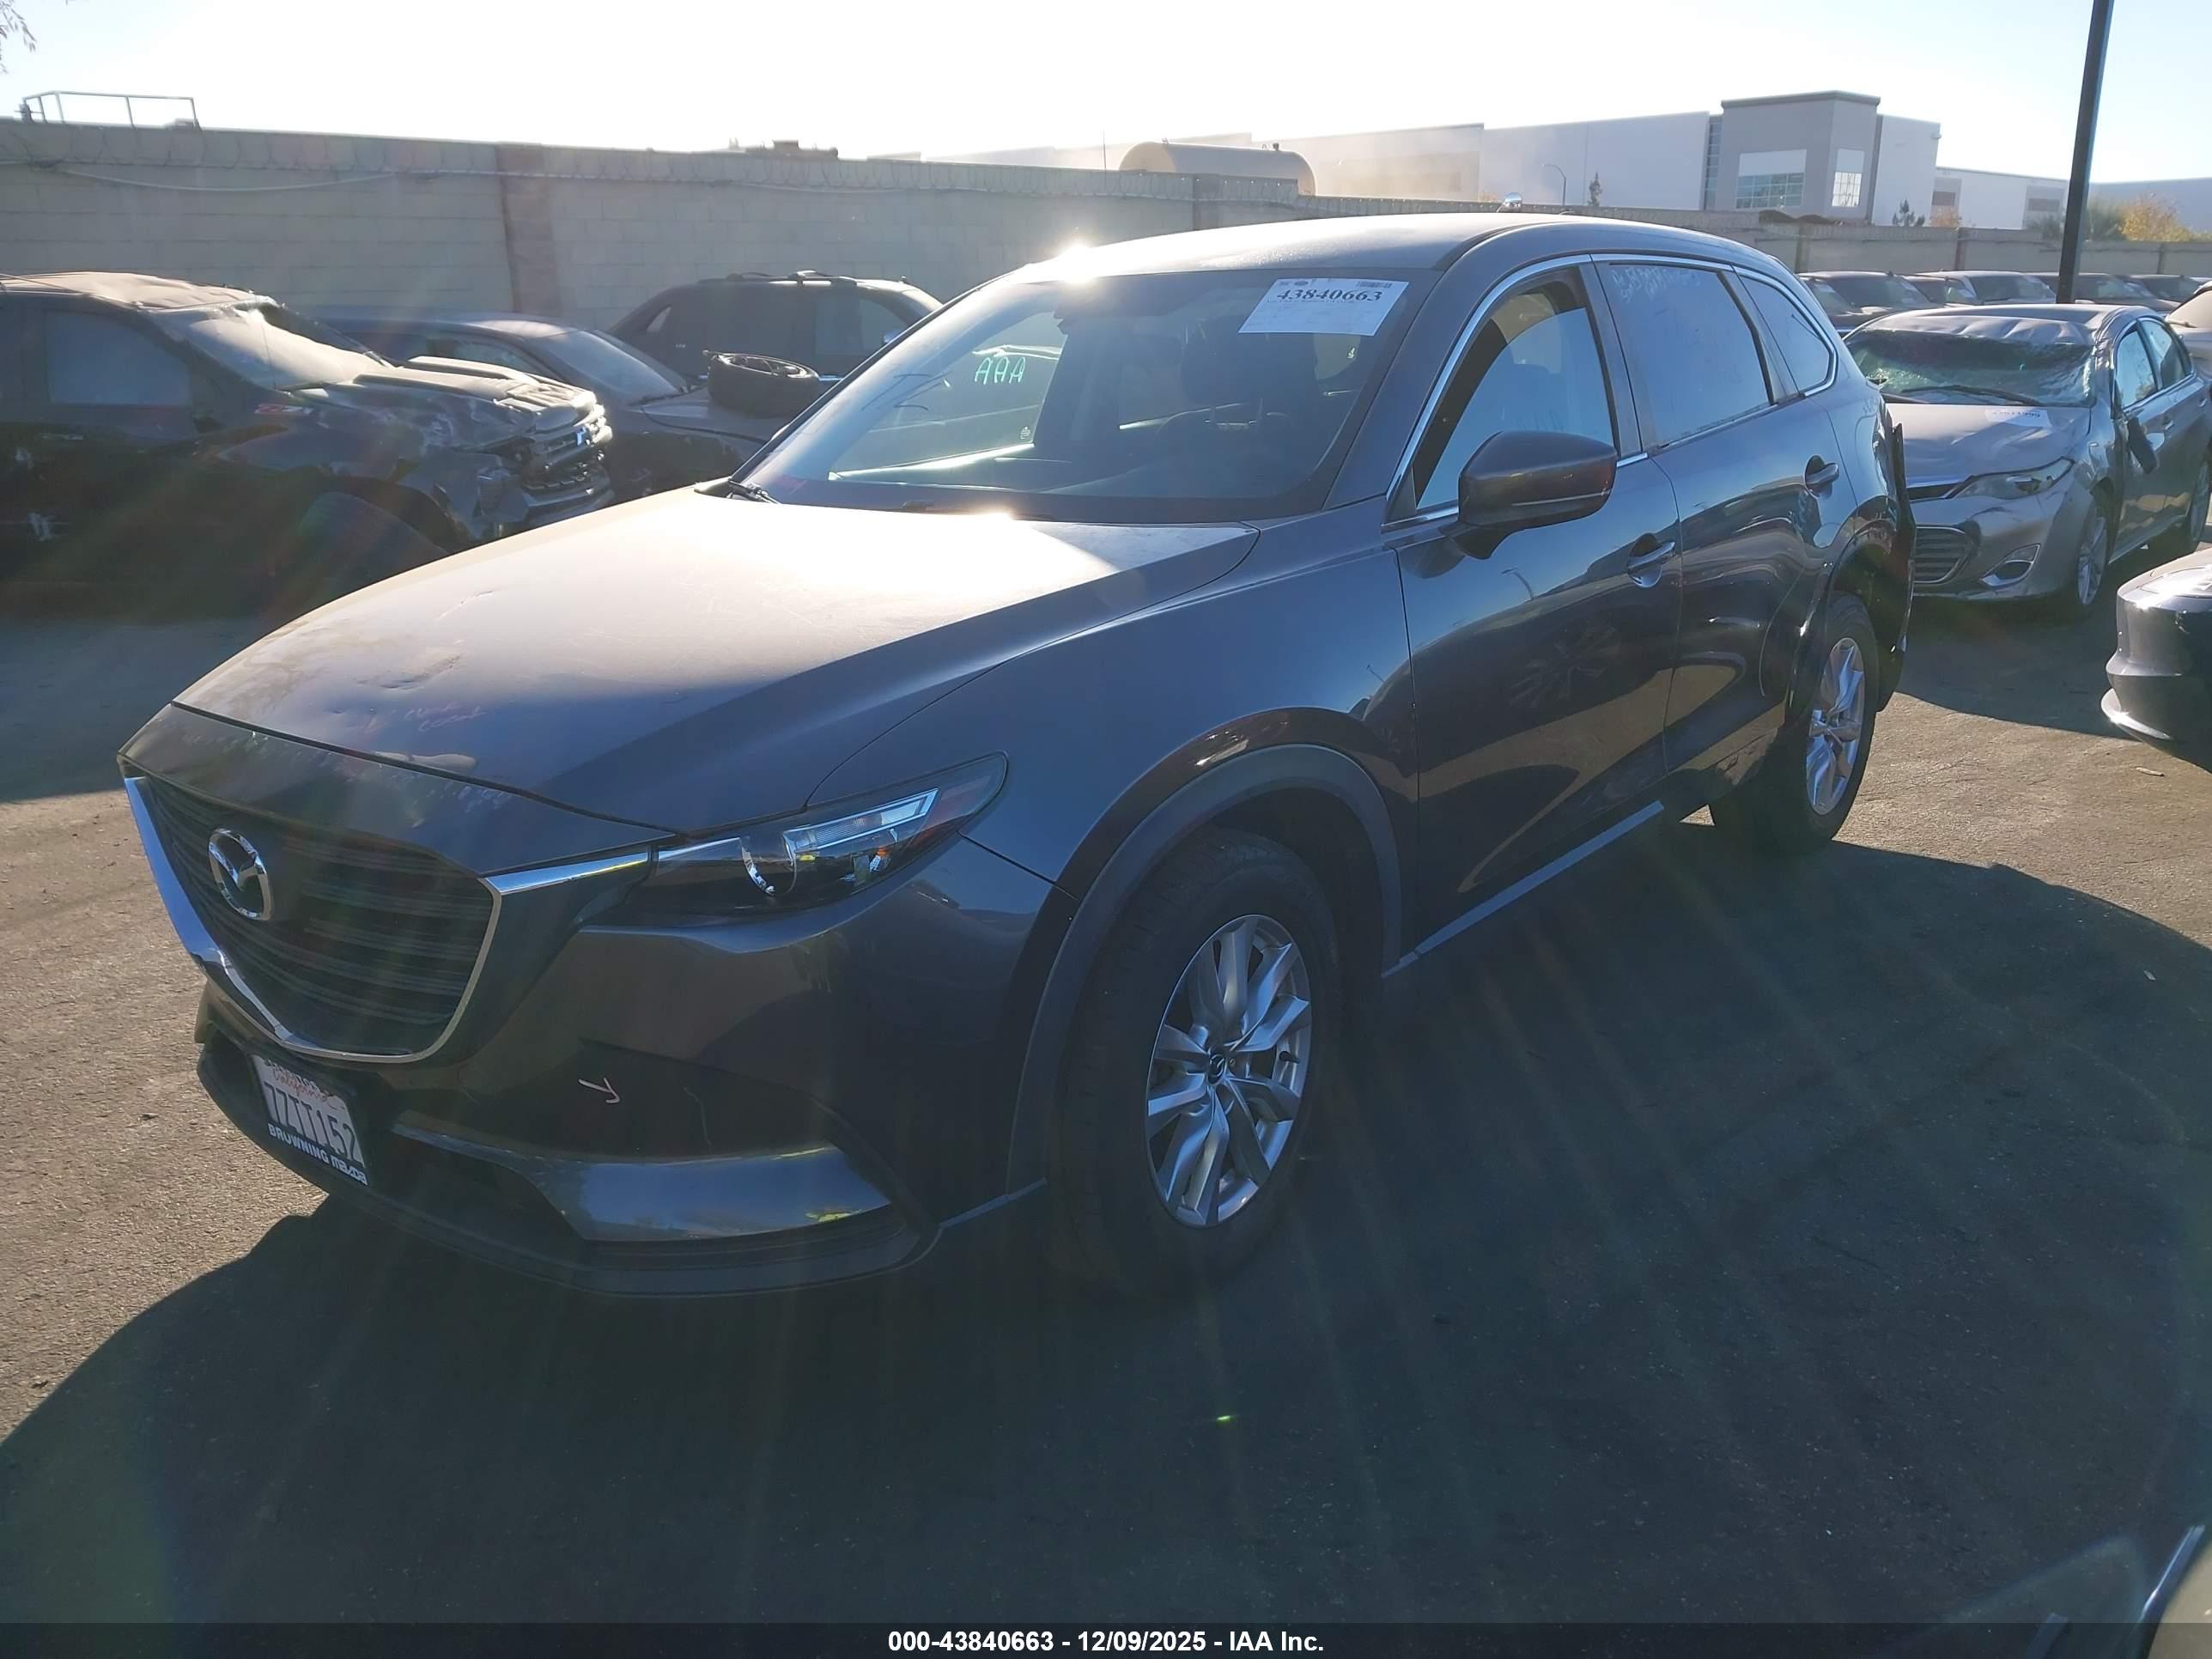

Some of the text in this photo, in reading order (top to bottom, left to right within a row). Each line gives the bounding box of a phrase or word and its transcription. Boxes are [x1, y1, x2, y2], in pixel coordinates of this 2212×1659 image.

[1277, 289, 1382, 301] 43840663
[974, 356, 1026, 385] AAA
[264, 1081, 365, 1164] 7ZTT152
[268, 1123, 330, 1164] BROWNING
